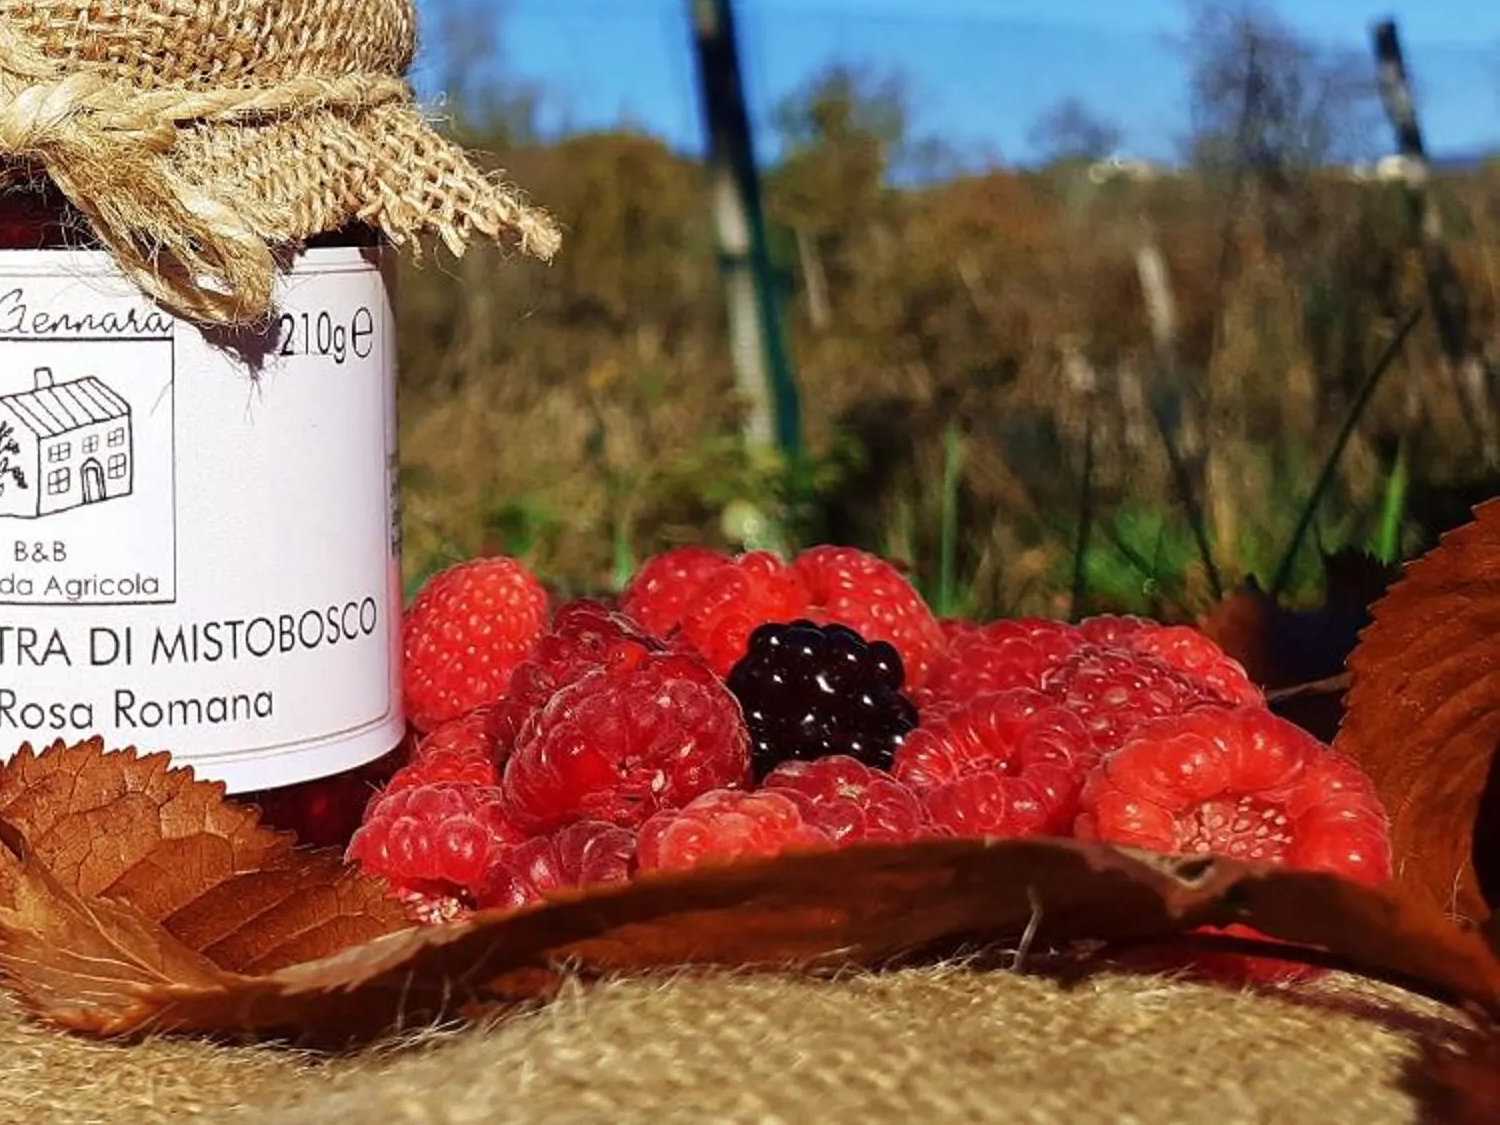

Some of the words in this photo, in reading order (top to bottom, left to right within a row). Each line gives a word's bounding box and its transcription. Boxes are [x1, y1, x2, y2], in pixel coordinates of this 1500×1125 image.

[14, 540, 68, 563] B&B
[43, 573, 160, 603] Agricola
[90, 625, 133, 667] DI
[152, 596, 378, 664] MISTOBOSCO
[115, 686, 275, 728] Romana
